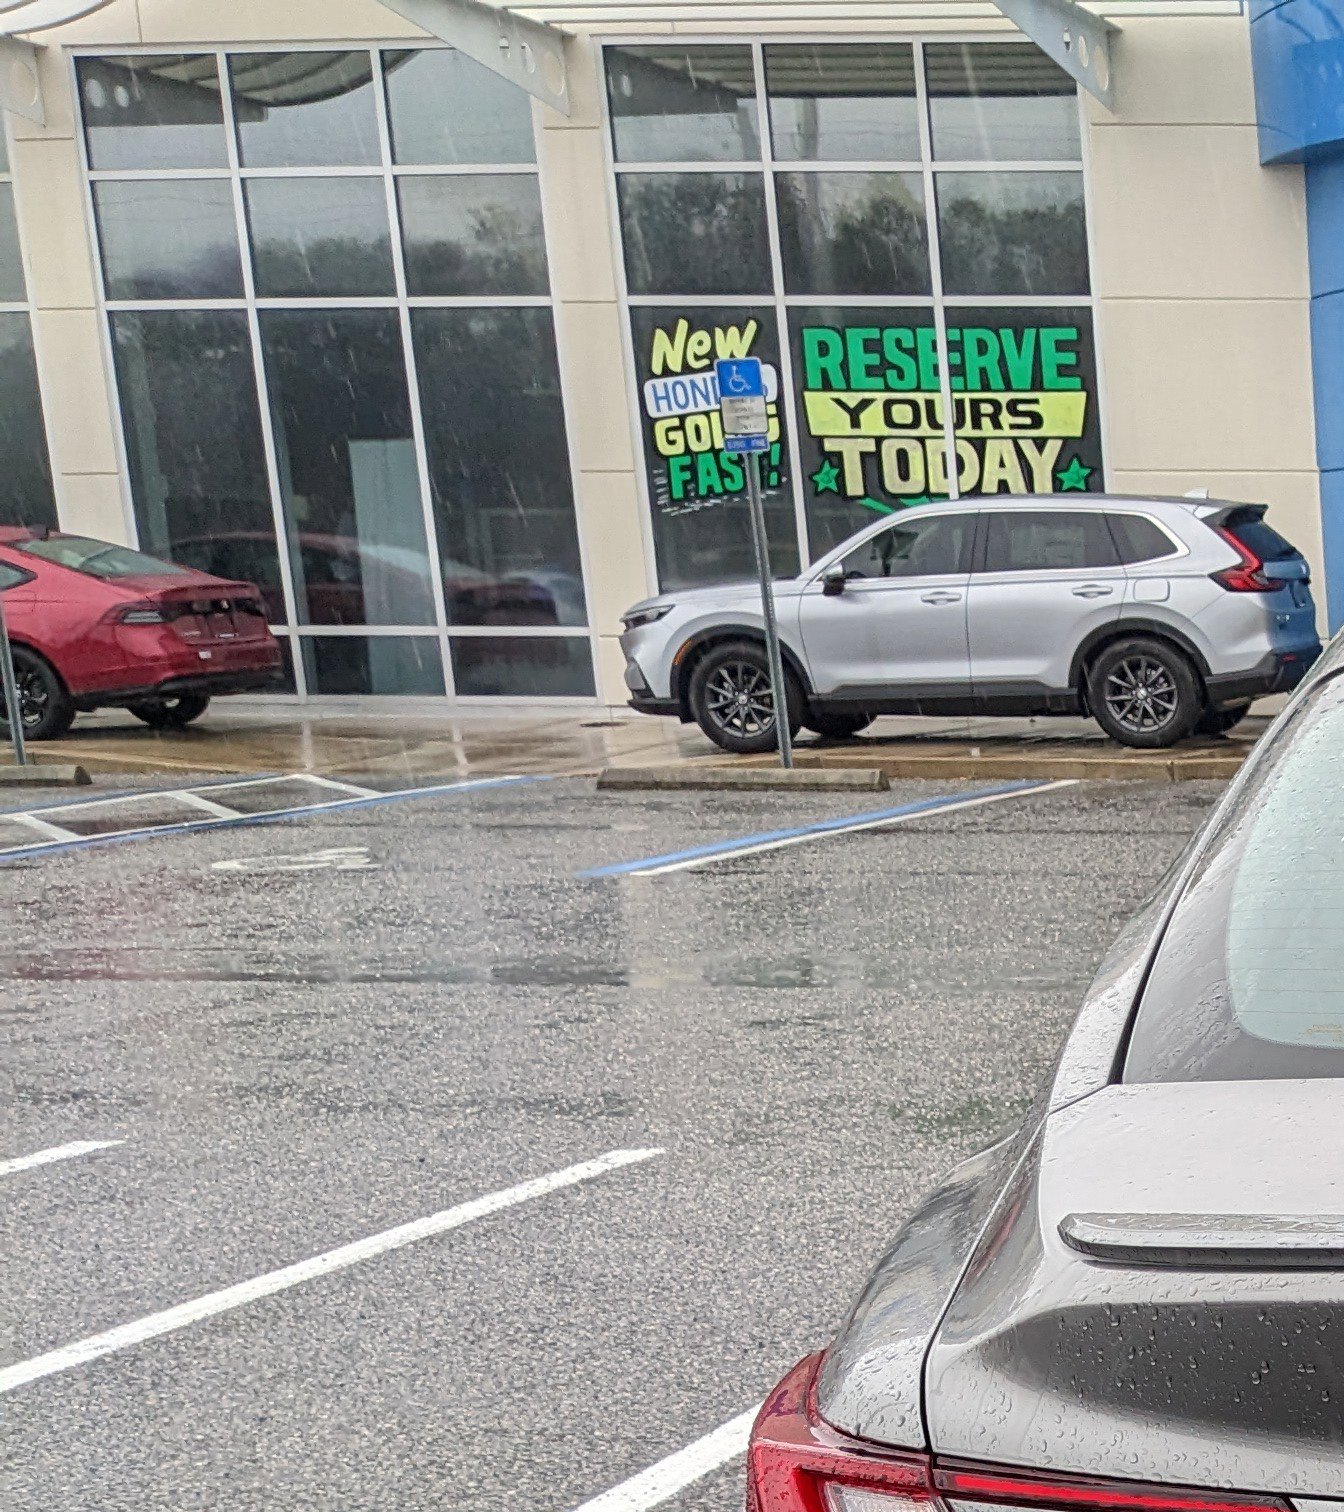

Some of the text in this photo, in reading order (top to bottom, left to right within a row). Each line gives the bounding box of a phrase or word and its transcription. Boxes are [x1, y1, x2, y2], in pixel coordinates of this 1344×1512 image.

[651, 317, 758, 376] New
[802, 327, 1082, 391] RESERVE
[651, 373, 769, 413] HON
[830, 397, 1044, 431] YOURS
[654, 403, 780, 456] GOI
[669, 442, 781, 500] FAS!
[823, 437, 1064, 497] TODAY
